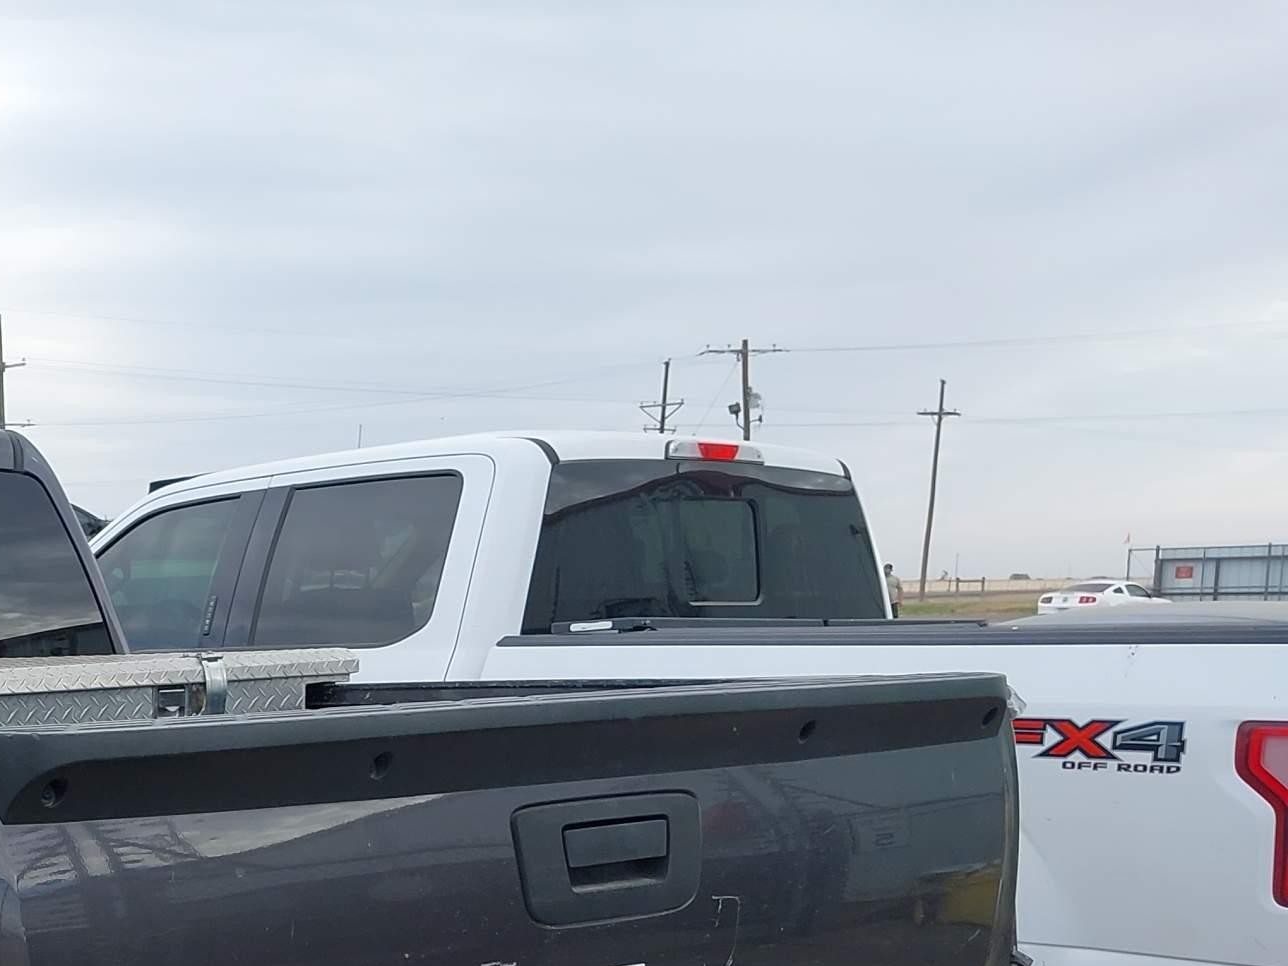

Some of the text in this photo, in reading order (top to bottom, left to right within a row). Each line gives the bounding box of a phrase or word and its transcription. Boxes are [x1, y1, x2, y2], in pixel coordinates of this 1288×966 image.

[1012, 718, 1187, 764] FX4
[1061, 760, 1182, 775] OFF ROAD
